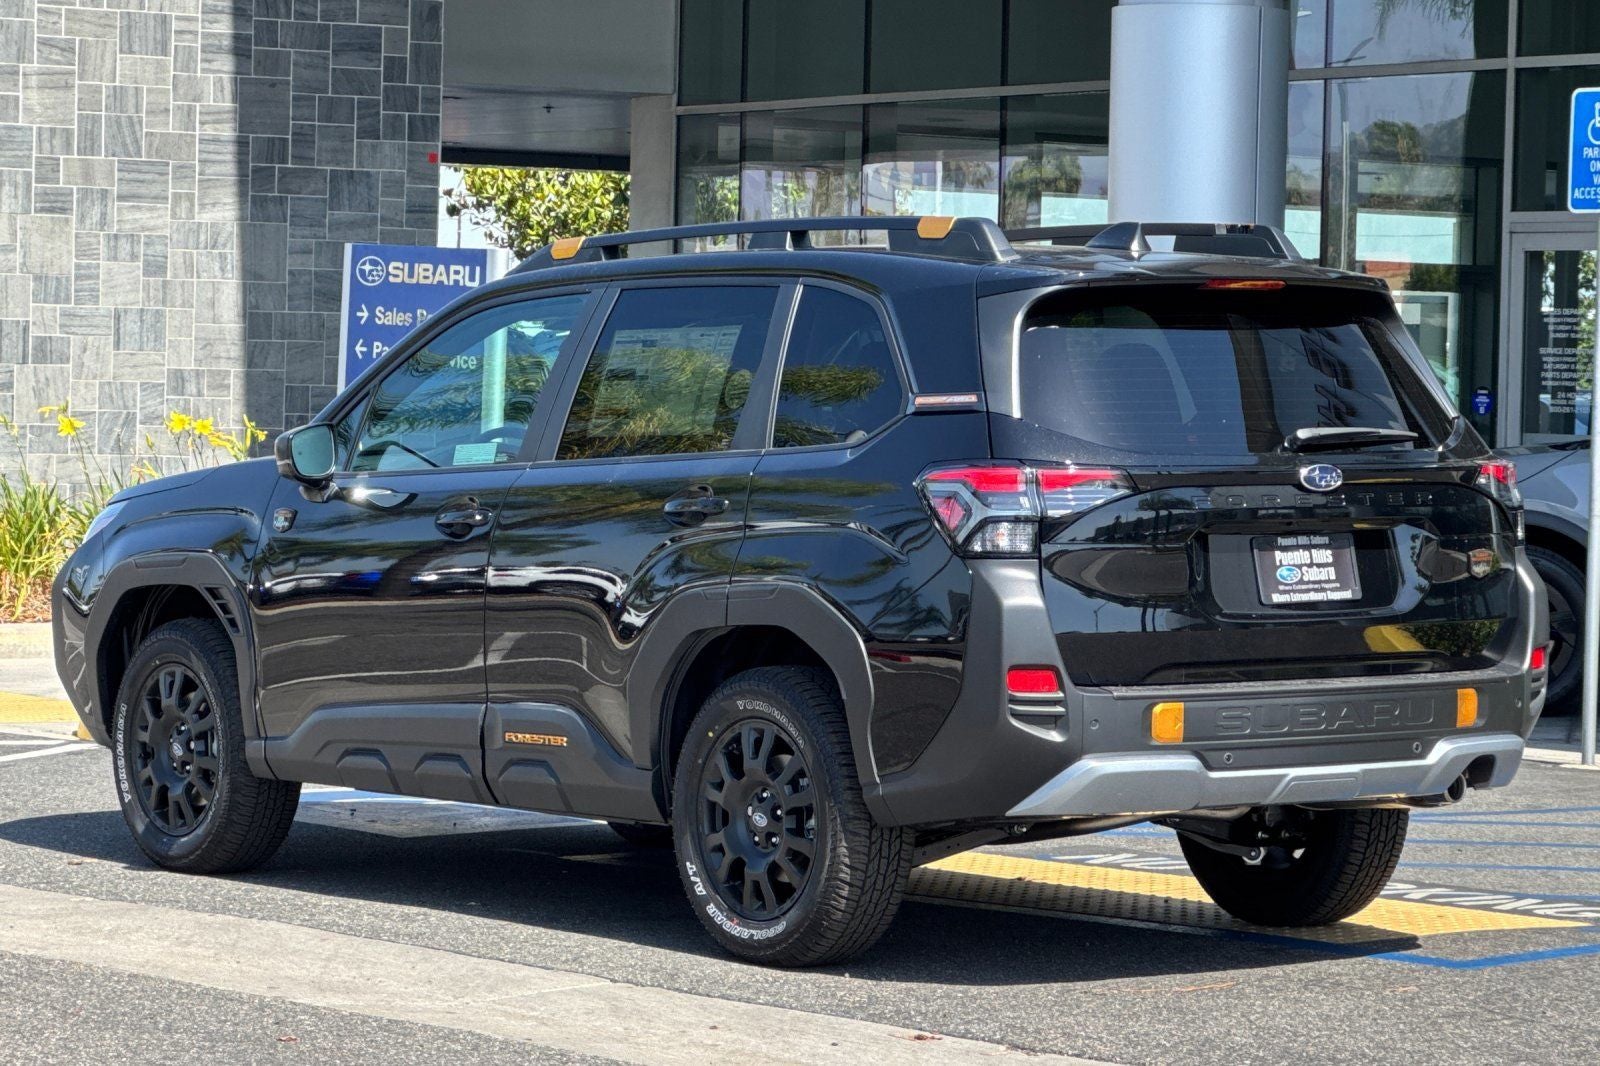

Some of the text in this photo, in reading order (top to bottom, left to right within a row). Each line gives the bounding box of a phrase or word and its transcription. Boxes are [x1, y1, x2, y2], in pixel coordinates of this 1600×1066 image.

[1583, 146, 1600, 159] PAR
[388, 261, 480, 287] SUBARU
[375, 305, 413, 327] Sales
[1191, 492, 1433, 508] FORESTER
[1277, 535, 1329, 546] Puente Hills Subaru
[1274, 548, 1333, 566] Puente Hills
[1301, 565, 1336, 581] Subaru
[1271, 593, 1290, 602] Where
[1290, 591, 1327, 602] Extraordinary
[736, 699, 805, 749] YOKOHAMA
[1214, 699, 1435, 735] SUBARU
[504, 731, 568, 747] FORESTER
[116, 703, 131, 803] YOKOHAMA
[685, 861, 787, 940] GEOLANDAR A/T
